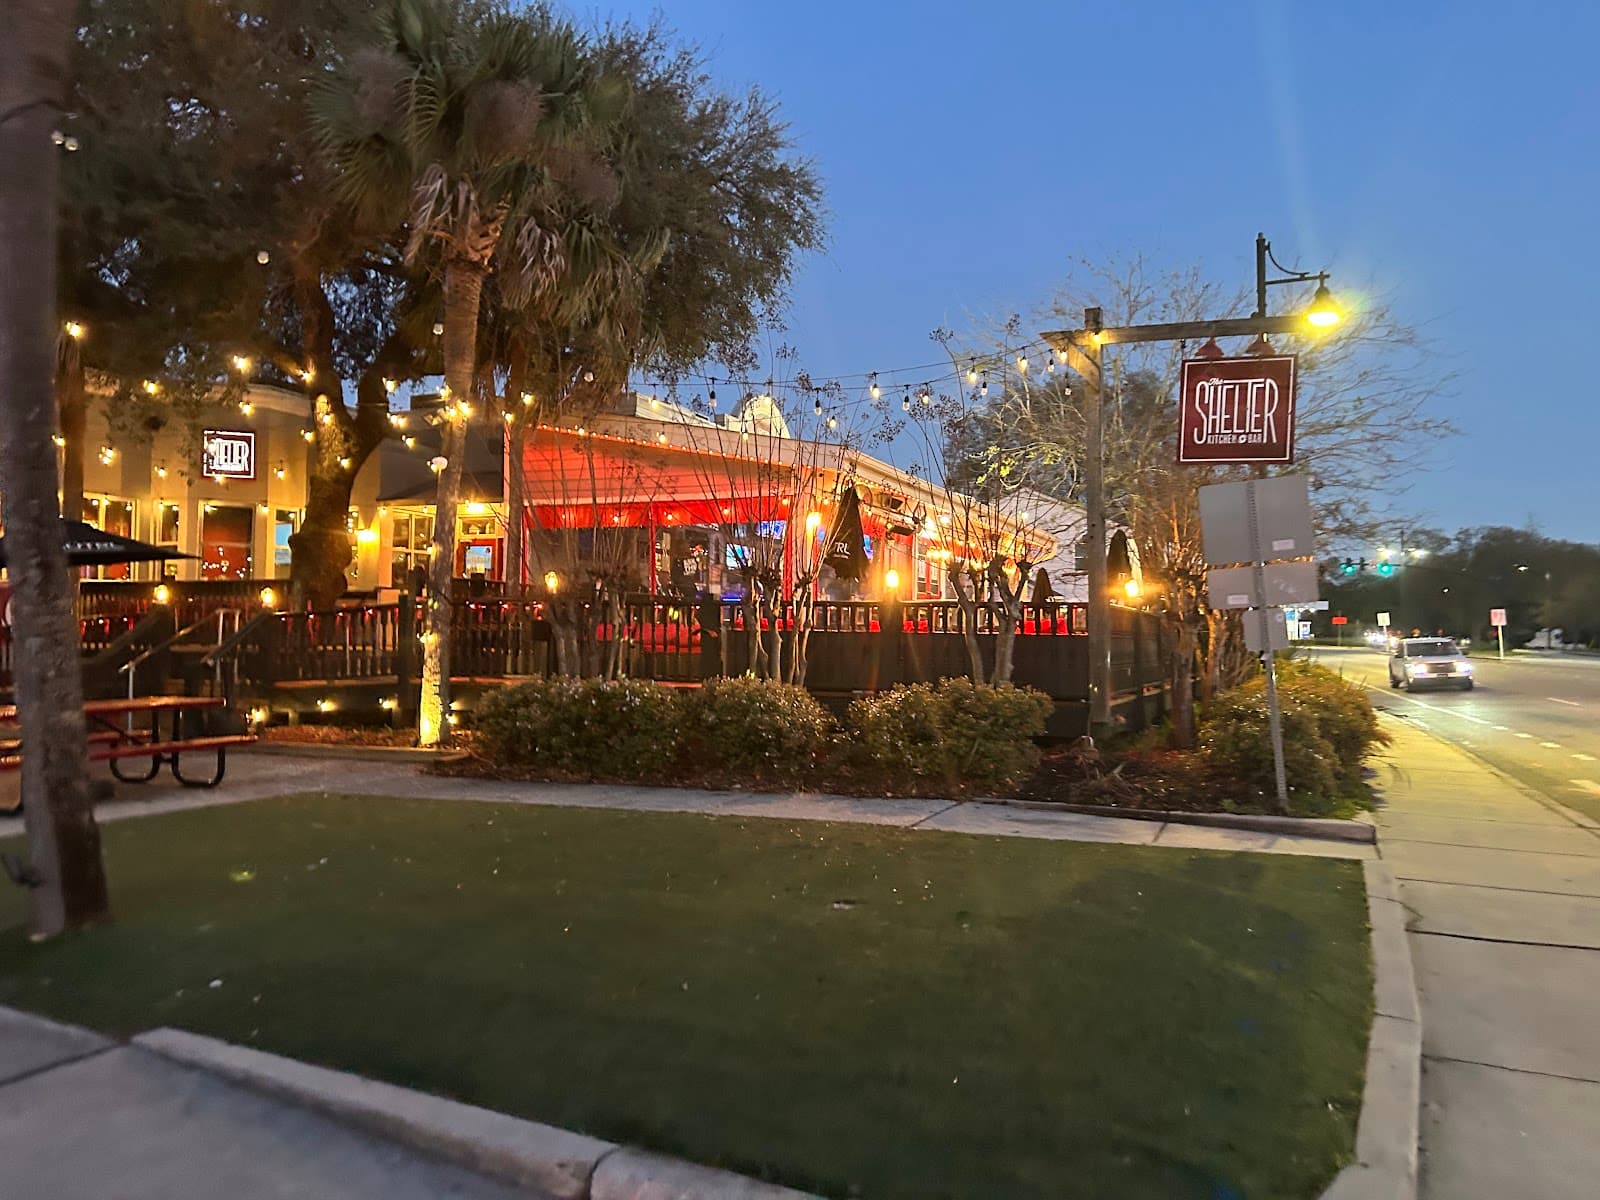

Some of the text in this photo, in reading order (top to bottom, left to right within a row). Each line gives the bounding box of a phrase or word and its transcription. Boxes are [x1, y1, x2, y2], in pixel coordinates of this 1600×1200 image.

[1194, 378, 1278, 444] SHELTER
[1207, 434, 1237, 445] KITCHEN
[1248, 433, 1263, 444] BAR
